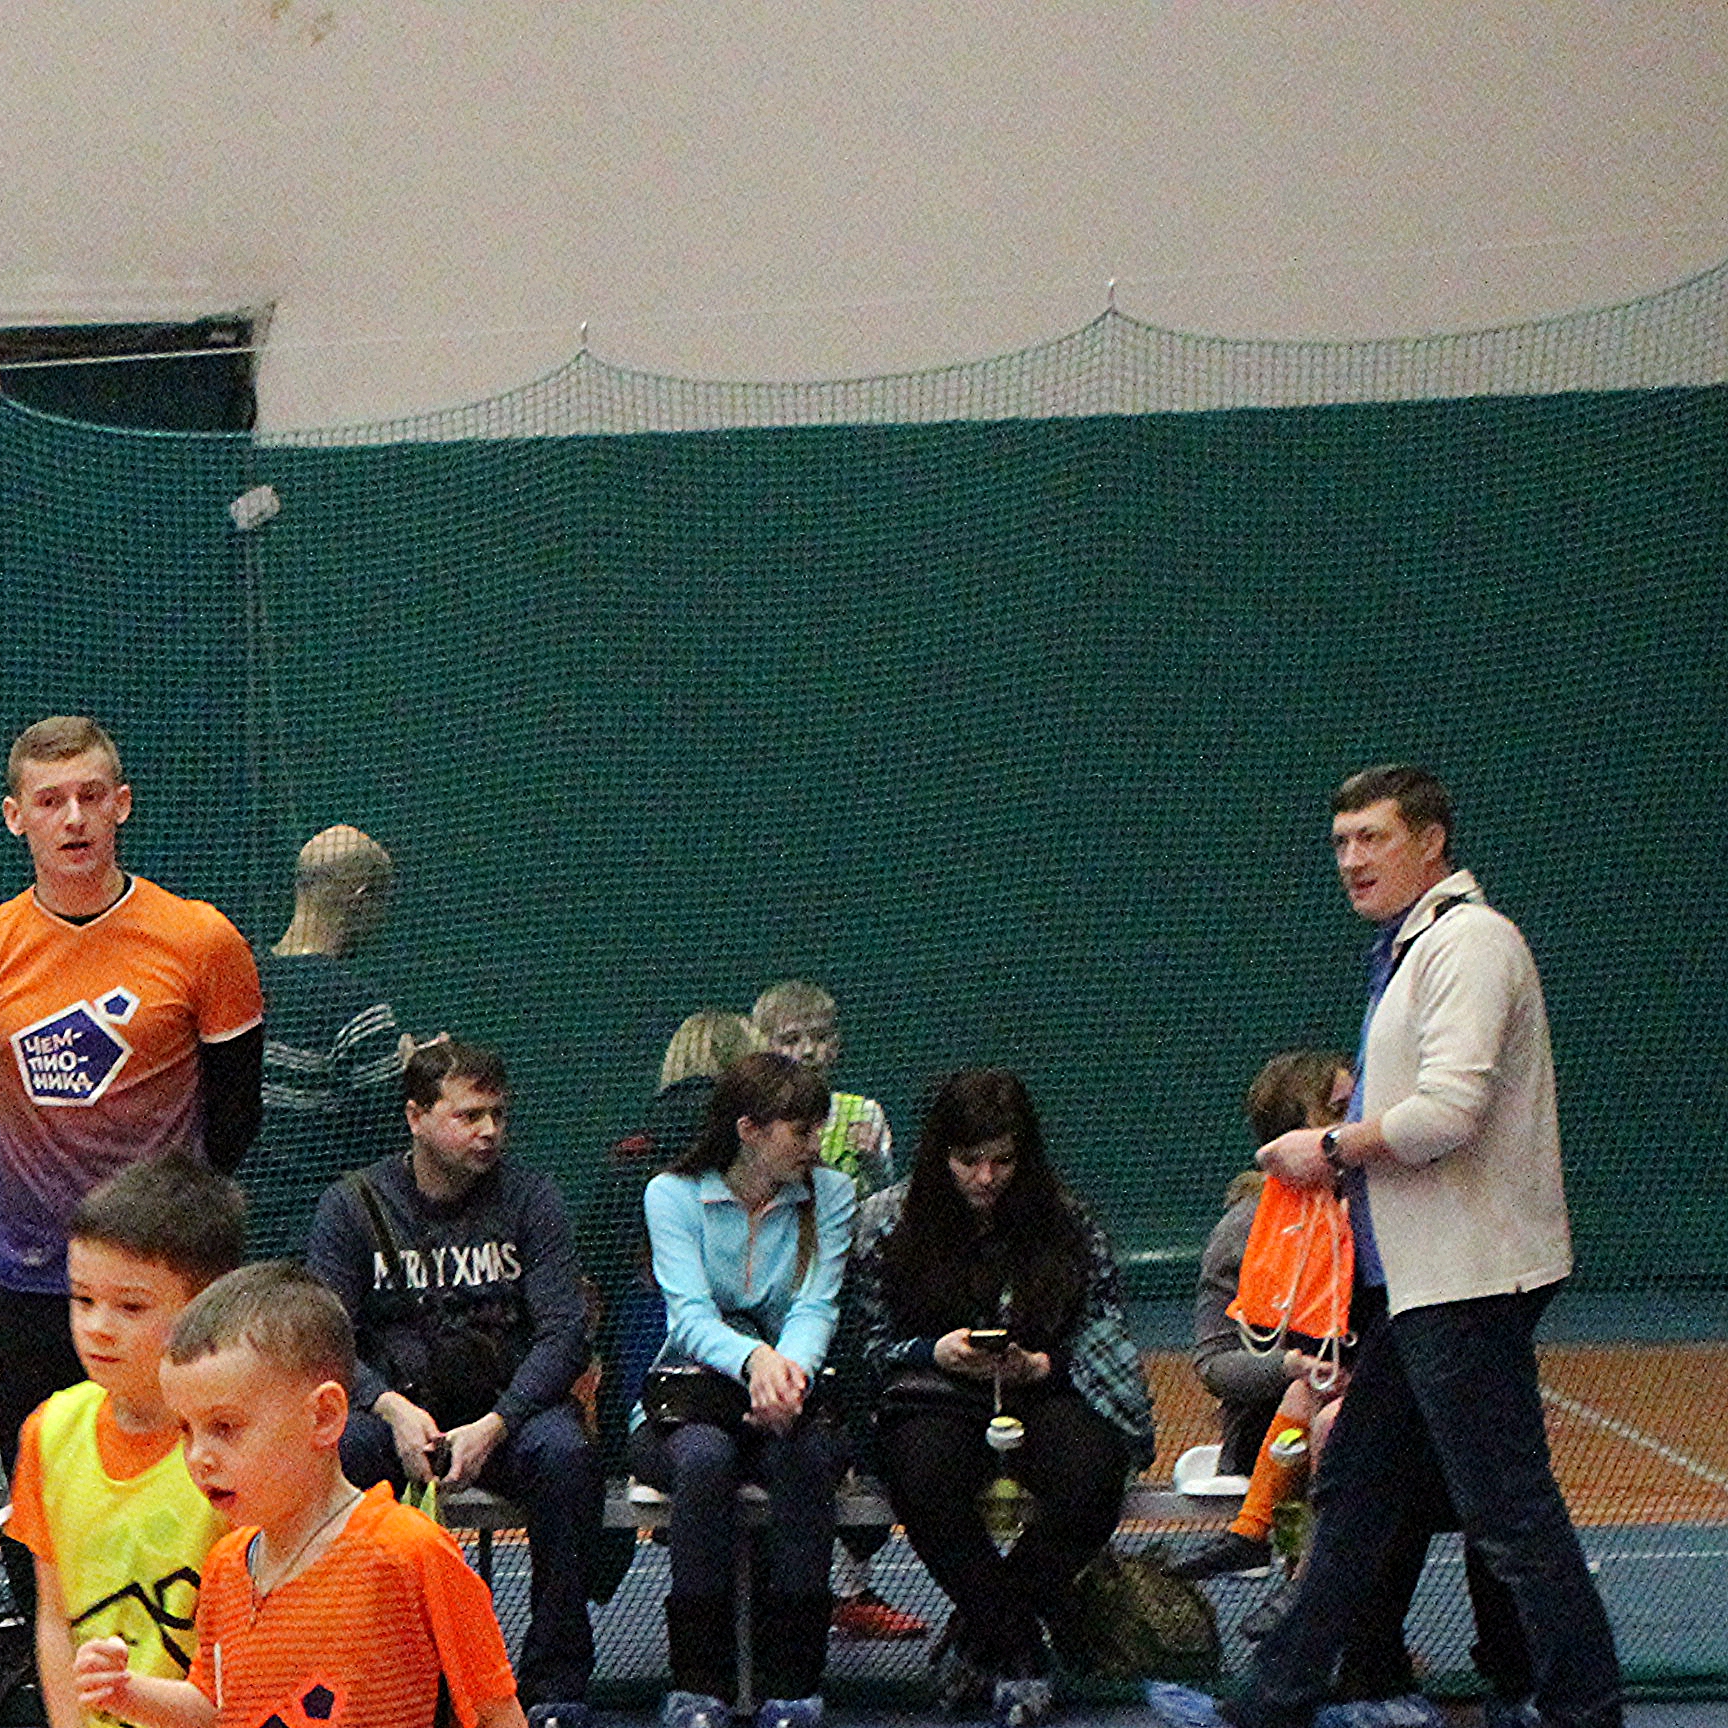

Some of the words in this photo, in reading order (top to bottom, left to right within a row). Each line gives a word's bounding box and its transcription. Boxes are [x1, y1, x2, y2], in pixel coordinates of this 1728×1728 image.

[24, 1027, 83, 1055] ЧЕМ-
[27, 1050, 89, 1072] ПИО-
[32, 1071, 94, 1093] НИКА
